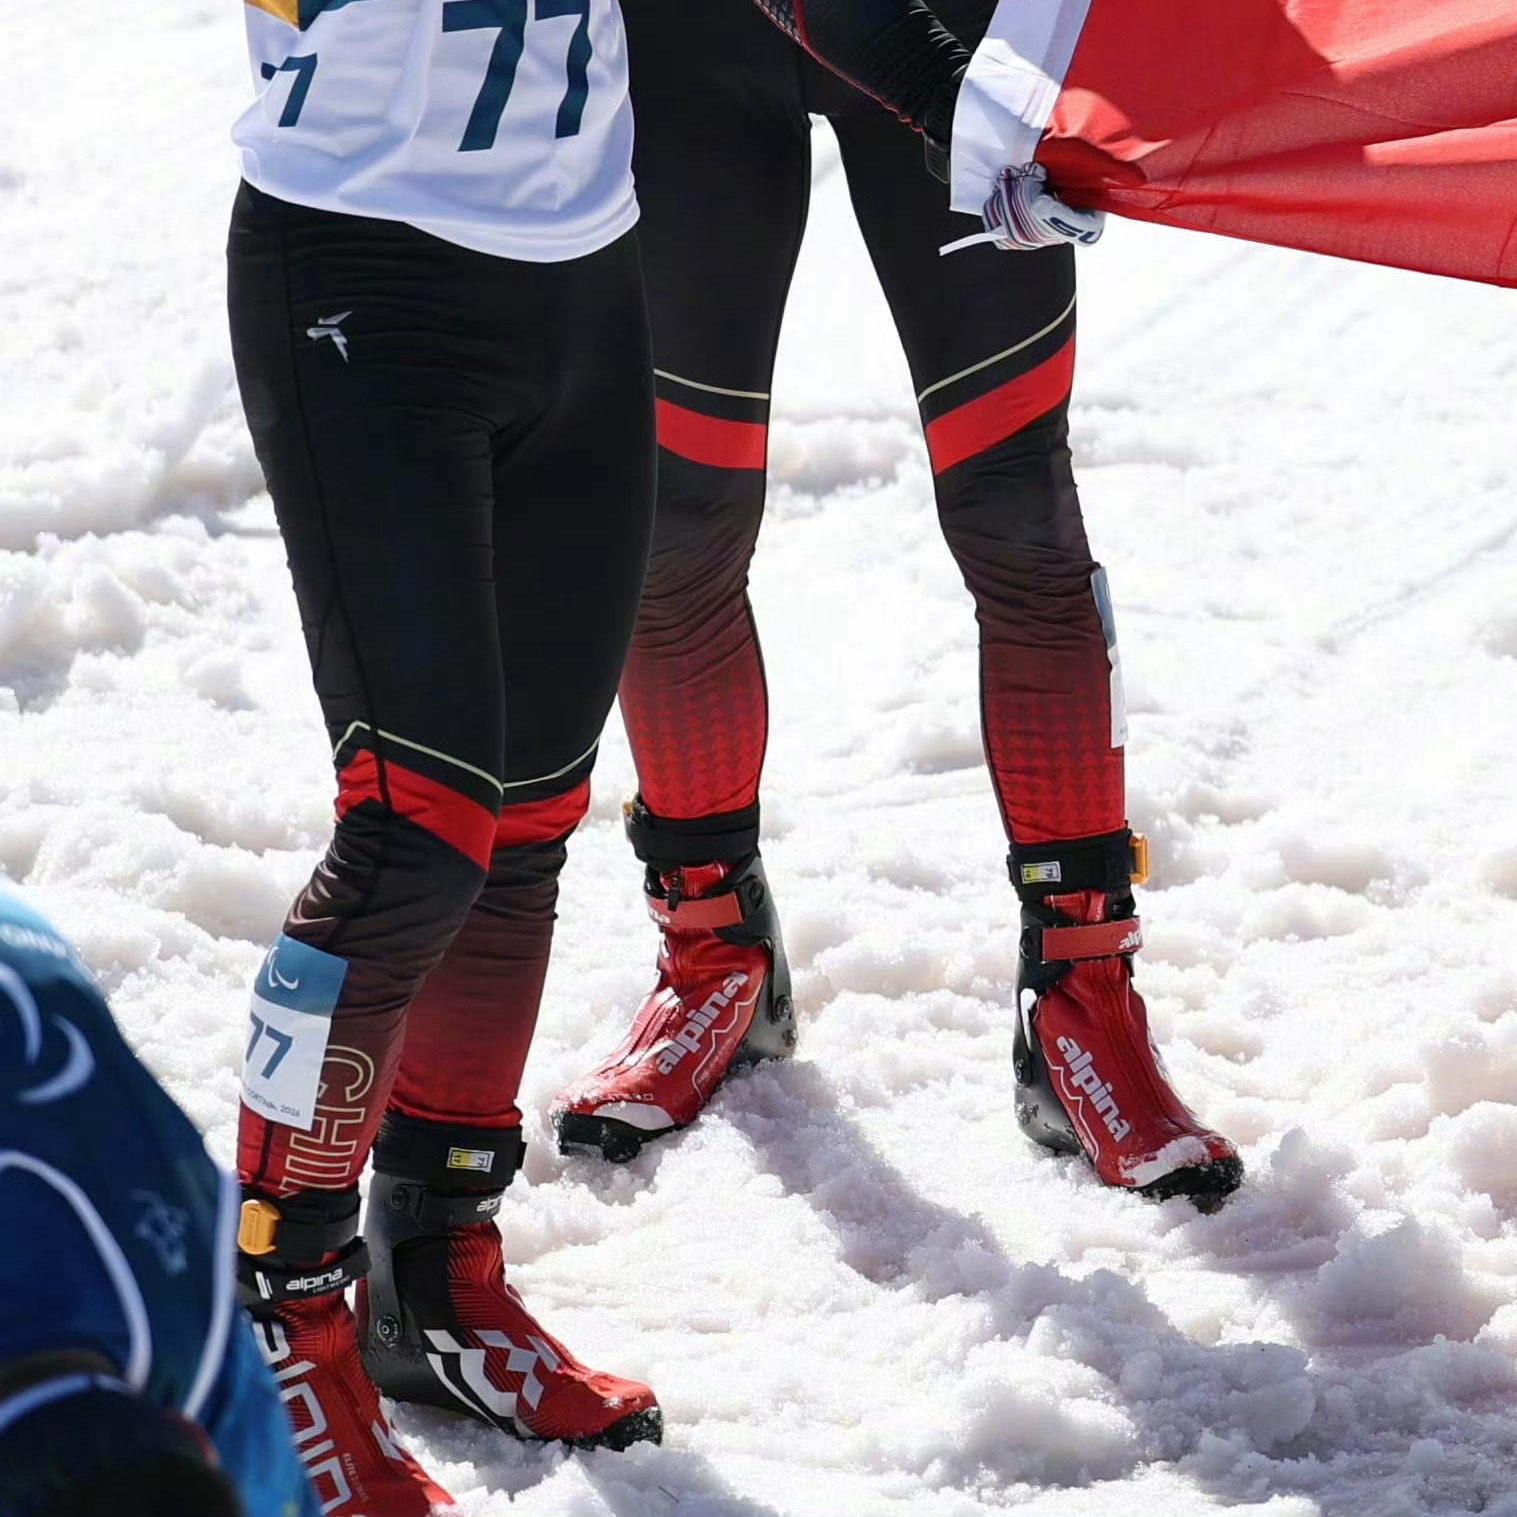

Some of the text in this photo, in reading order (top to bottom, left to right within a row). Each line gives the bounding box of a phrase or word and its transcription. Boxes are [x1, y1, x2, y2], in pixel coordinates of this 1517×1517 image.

[246, 1009, 294, 1080] 77
[656, 971, 749, 1075] alpina
[1056, 1035, 1132, 1143] alpina
[286, 1268, 343, 1292] alpina
